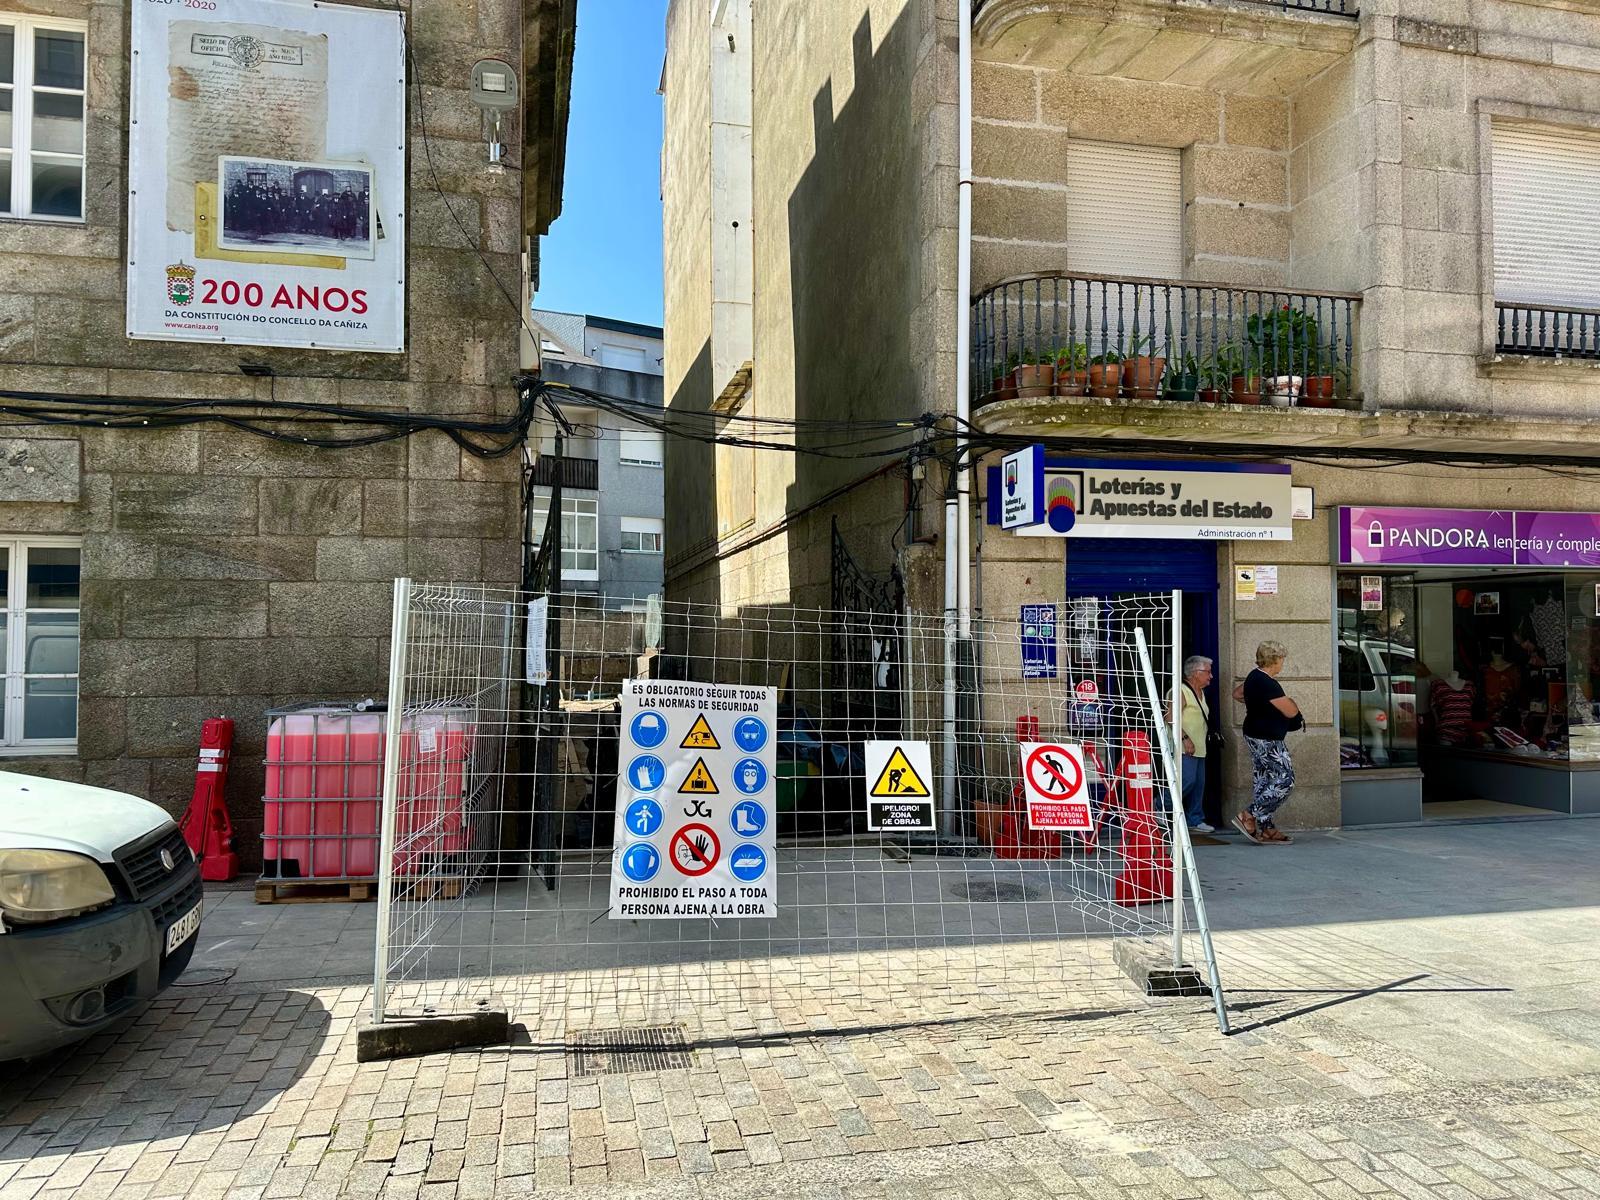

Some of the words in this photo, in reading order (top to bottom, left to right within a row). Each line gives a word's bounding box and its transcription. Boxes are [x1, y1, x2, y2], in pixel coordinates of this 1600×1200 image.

[185, 0, 217, 11] 2020
[201, 278, 264, 307] 200
[270, 283, 368, 315] ANOS
[164, 310, 179, 318] DA
[181, 311, 250, 322] CONSTITUCIÓN
[252, 315, 267, 323] DO
[268, 316, 317, 326] CONCELLO
[318, 319, 332, 327] DA
[333, 319, 368, 330] CAÑIZA
[164, 322, 219, 331] www.caniza.org
[1089, 476, 1166, 496] Loterías
[1170, 483, 1182, 500] y
[1090, 498, 1177, 521] Apuestas
[1180, 499, 1209, 518] del
[1212, 501, 1273, 519] Estado
[1197, 528, 1257, 538] Administración
[1389, 527, 1489, 548] PANDORA
[1493, 534, 1543, 550] lencería
[1546, 538, 1553, 554] y
[1556, 536, 1600, 554] comple
[632, 684, 643, 695] ES
[646, 685, 704, 697] OBLIGATORIO
[706, 688, 737, 699] SEGUIR
[739, 690, 767, 700] TODAS
[639, 697, 656, 708] LAS
[658, 698, 696, 709] NORMAS
[698, 700, 709, 710] DE
[711, 700, 759, 712] SEGURIDAD
[881, 804, 920, 812] ¡PELIGRO!
[1031, 804, 1062, 812] PROHIBIDO
[1070, 805, 1086, 813] PASO
[890, 811, 912, 819] ZONA
[1056, 811, 1084, 819] PERSONA
[618, 887, 679, 898] PROHIBIDO
[682, 887, 695, 898] EL
[698, 887, 726, 898] PASO
[729, 887, 737, 898] A
[740, 887, 768, 898] TODA
[620, 903, 670, 915] PERSONA
[673, 904, 708, 915] AJENA
[710, 904, 718, 915] A
[721, 904, 734, 915] LA
[737, 904, 765, 915] OBRA
